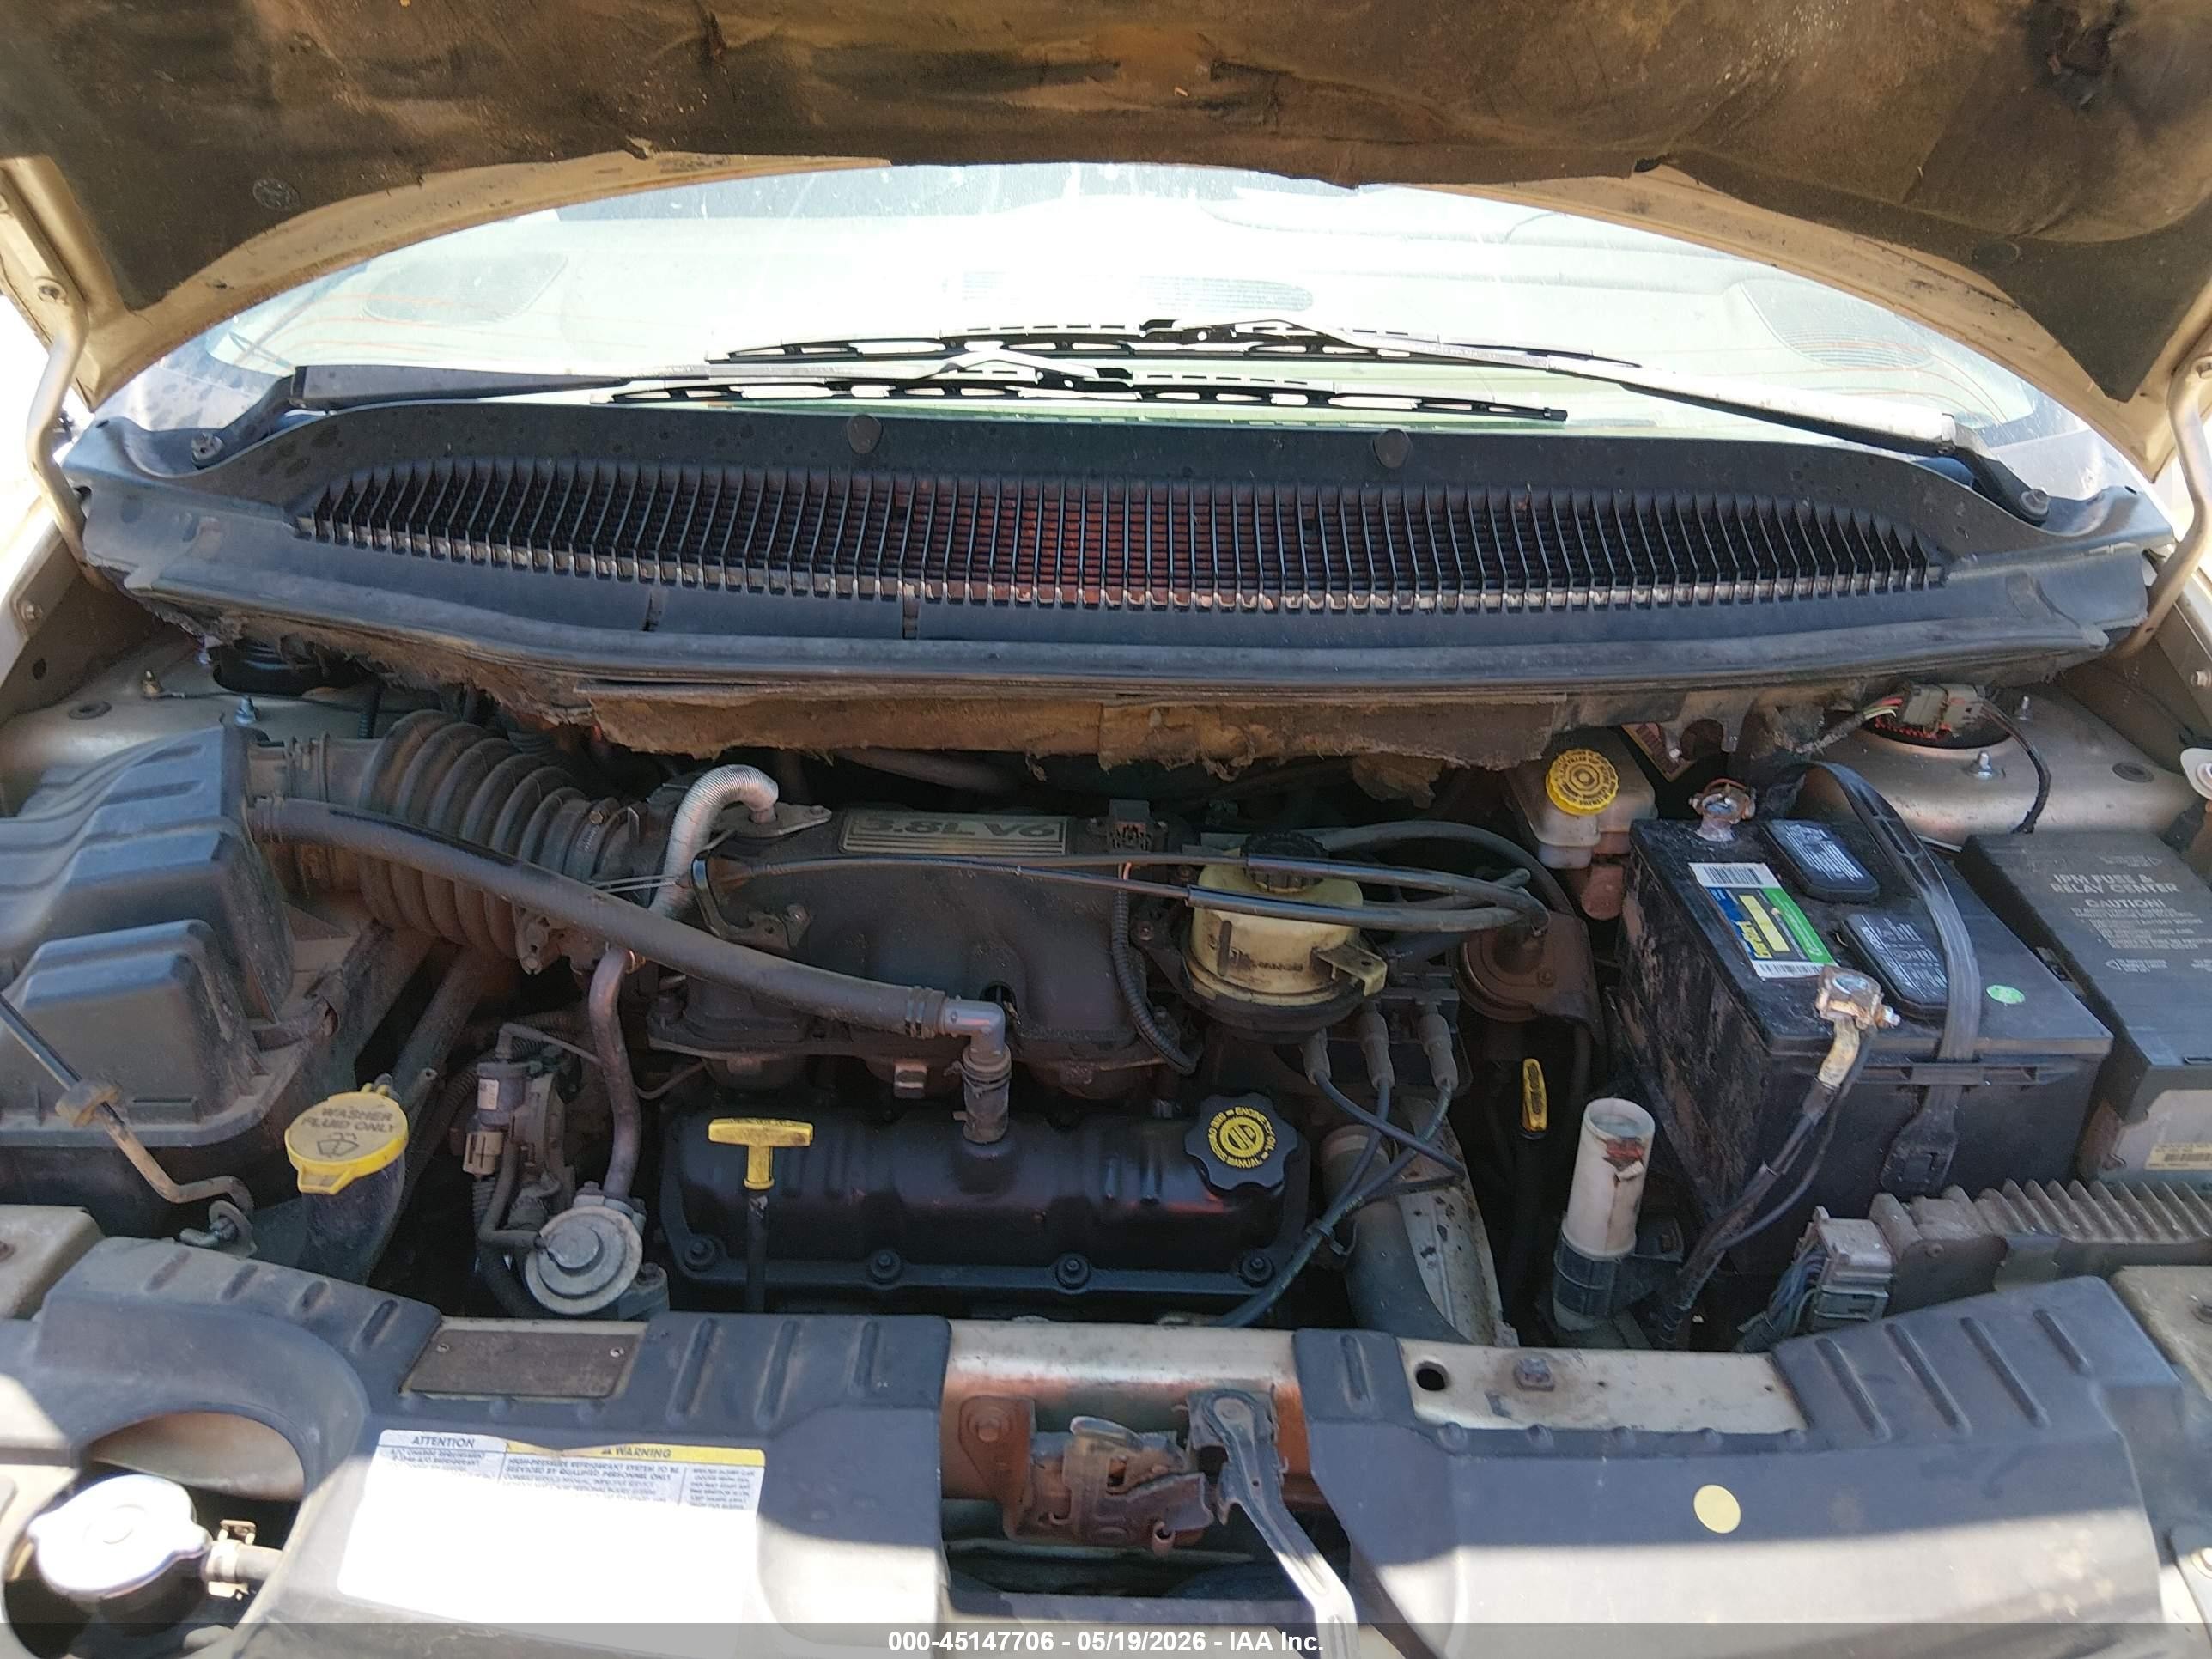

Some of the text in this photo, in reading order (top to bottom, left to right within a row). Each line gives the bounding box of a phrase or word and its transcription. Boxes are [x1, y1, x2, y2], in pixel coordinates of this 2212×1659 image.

[859, 817, 1056, 838] 3.8L V6
[2050, 883, 2181, 893] RELAY CENTER
[321, 1107, 393, 1121] WASHER
[301, 1116, 396, 1133] FLUID ONLY
[411, 1436, 475, 1448] ATTENTION
[616, 1447, 672, 1458] WARNING
